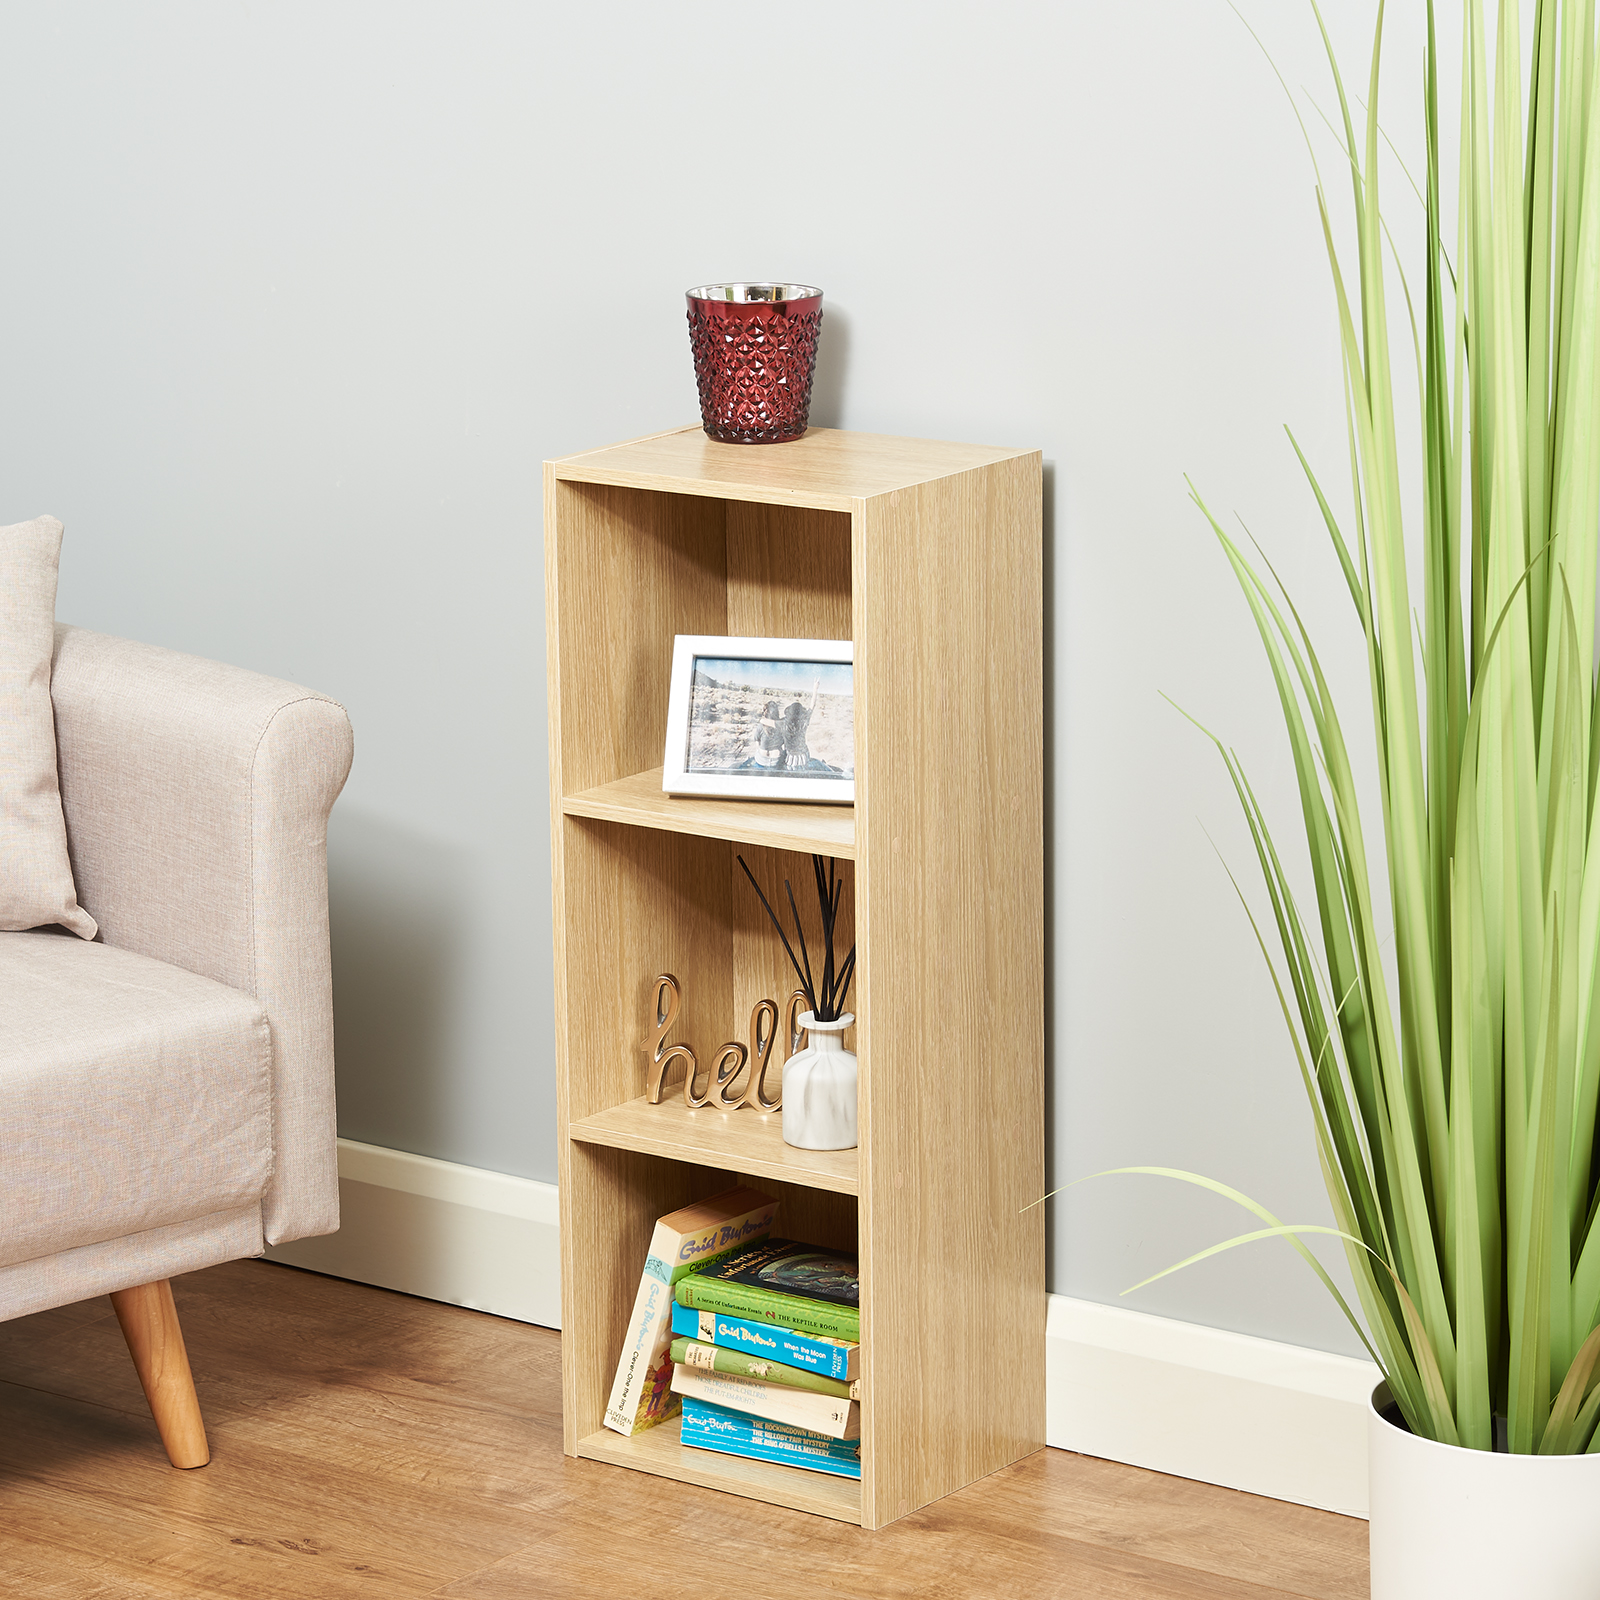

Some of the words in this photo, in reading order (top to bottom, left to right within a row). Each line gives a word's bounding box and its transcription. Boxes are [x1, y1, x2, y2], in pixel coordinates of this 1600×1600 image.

[679, 1232, 718, 1260] Enid
[720, 1214, 773, 1246] Blyton's
[645, 1283, 659, 1310] Enid
[722, 1302, 747, 1312] Unfortunate
[636, 1310, 655, 1350] Blyton's
[778, 1314, 791, 1322] THE
[793, 1317, 818, 1328] REPTILE
[819, 1321, 839, 1332] ROOM
[718, 1323, 740, 1340] Enid
[740, 1326, 777, 1348] Blyton's
[784, 1342, 799, 1351] When
[800, 1346, 810, 1354] the
[810, 1349, 827, 1359] Moon
[793, 1351, 804, 1361] Was
[805, 1355, 817, 1364] Blue
[625, 1350, 639, 1387] Clever-One
[709, 1370, 727, 1380] FAMILY
[729, 1374, 736, 1382] AT
[695, 1374, 712, 1385] THOSE
[713, 1379, 739, 1393] DREADFUL
[740, 1386, 767, 1400] CHILDREN
[704, 1386, 713, 1394] THE
[618, 1398, 626, 1411] Imp
[687, 1414, 707, 1426] Enid
[708, 1417, 738, 1432] Blyton
[752, 1420, 764, 1429] THE
[764, 1422, 807, 1437] ROCKINGDOWN
[807, 1430, 835, 1442] MYSTERY
[751, 1436, 763, 1445] THE
[763, 1439, 778, 1448] RING
[803, 1446, 831, 1457] MYSTERY
[752, 1429, 764, 1437] THE
[789, 1435, 802, 1444] FAIR
[803, 1438, 830, 1449] MYSTERY
